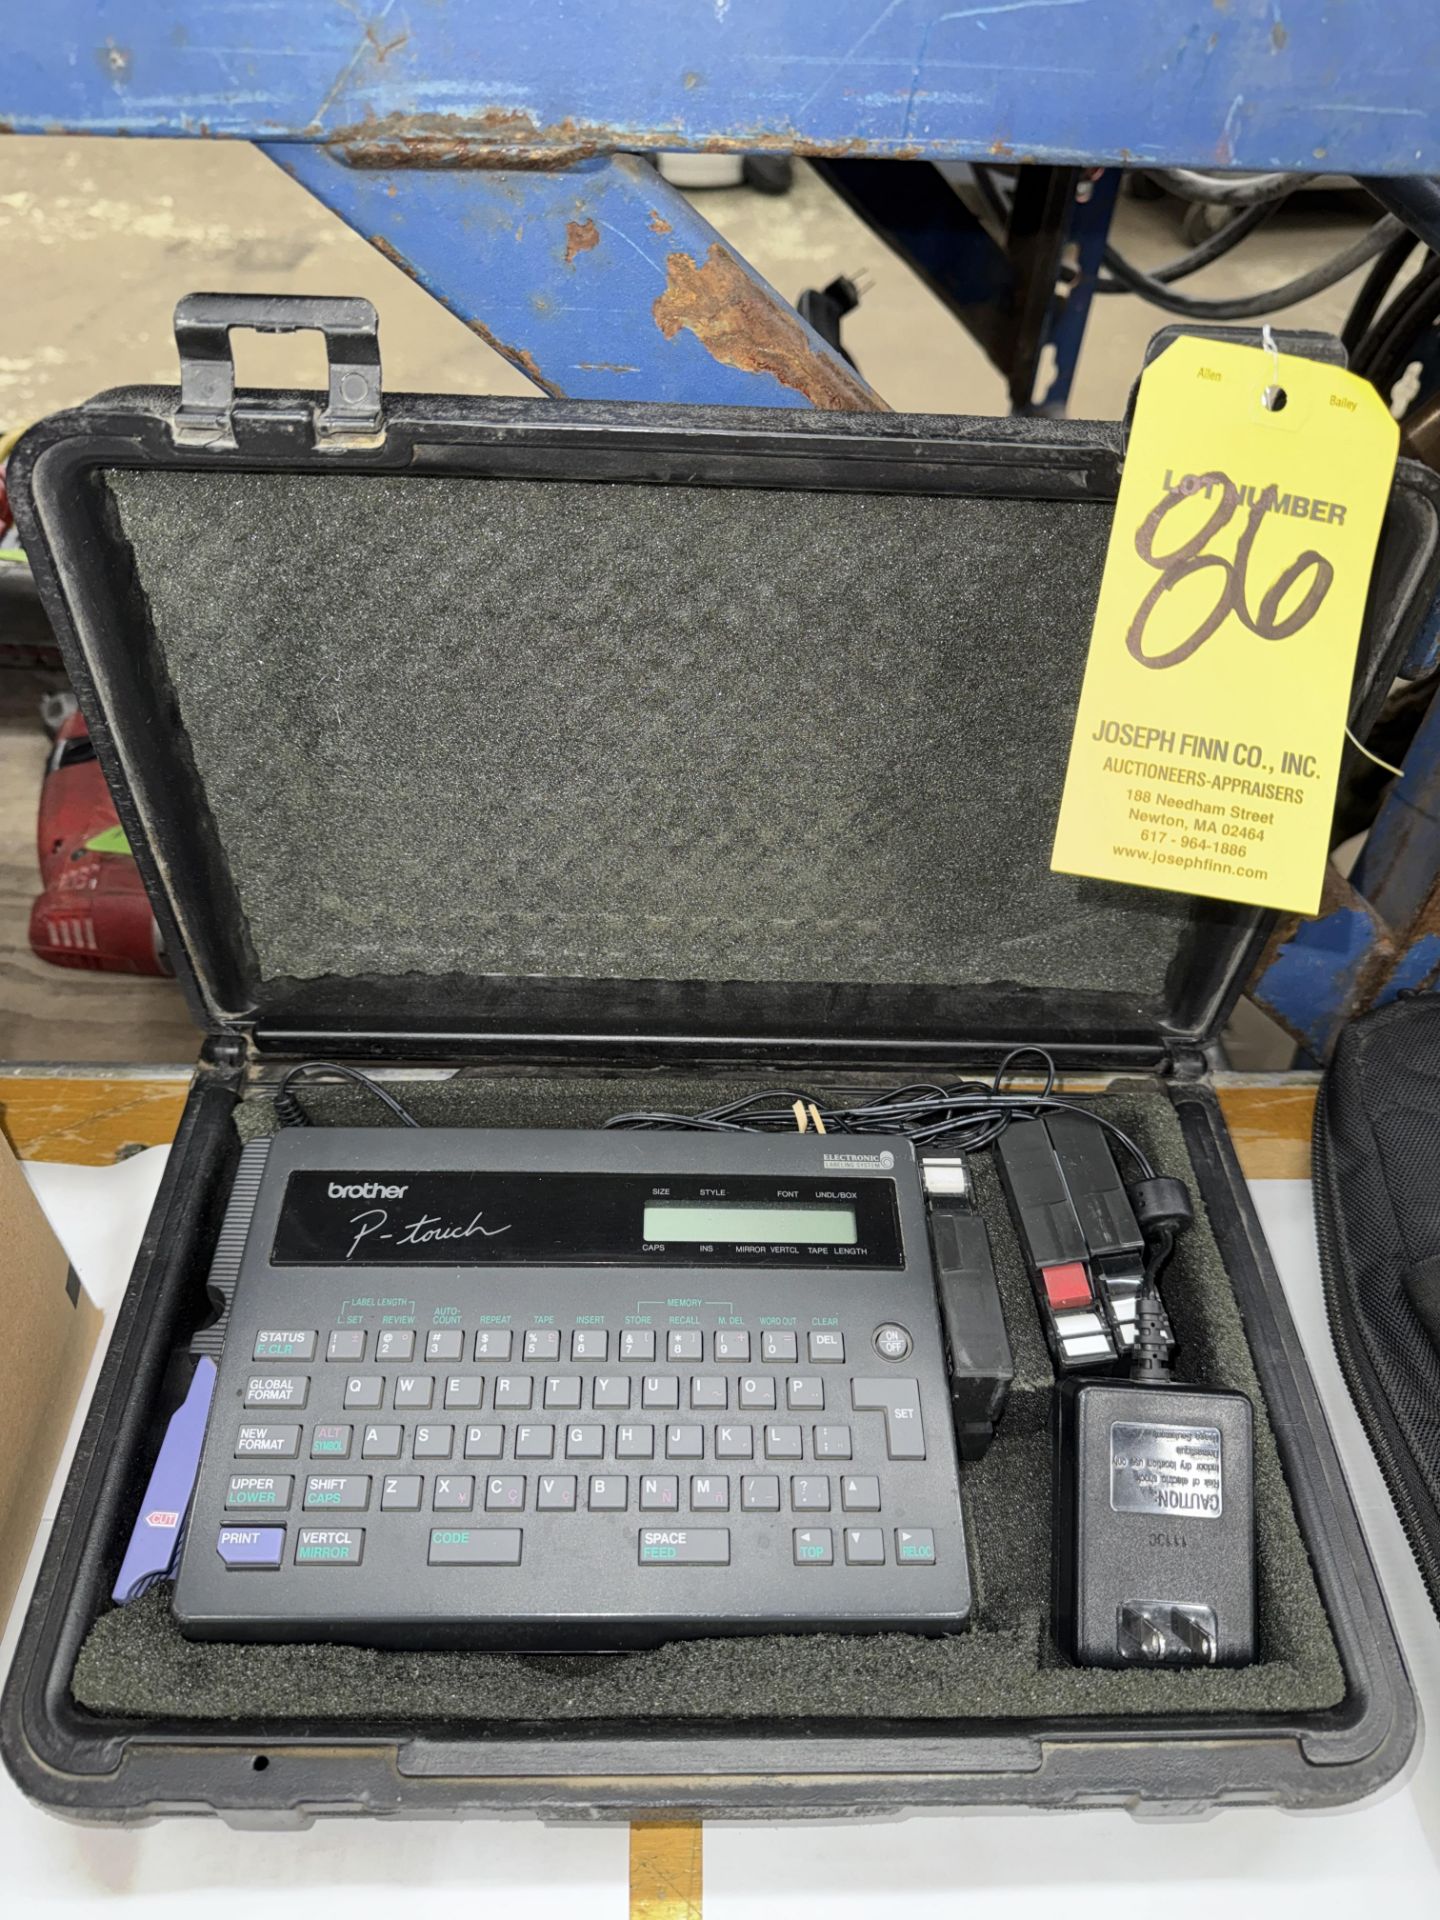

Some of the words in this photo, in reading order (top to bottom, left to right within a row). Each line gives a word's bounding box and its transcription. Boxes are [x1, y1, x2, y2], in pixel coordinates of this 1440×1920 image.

[1196, 367, 1222, 382] Allen
[1329, 394, 1358, 412] Bailey
[1162, 469, 1220, 499] LOT
[1234, 483, 1347, 526] NUMBER
[1125, 471, 1334, 670] 86
[1092, 720, 1175, 753] JOSEPH
[1179, 733, 1229, 762] FINN
[1233, 742, 1274, 774] CO.,
[1281, 751, 1321, 779] INC.
[1102, 756, 1304, 804] AUCTIONEERS-APPRAISERS
[1126, 789, 1151, 803] 188
[1156, 793, 1226, 816] Needham
[1230, 805, 1274, 825] Street
[1128, 807, 1188, 831] Newton,
[1193, 818, 1217, 834] MA
[1221, 824, 1265, 842] 02464
[1140, 829, 1167, 844] 617
[1180, 835, 1247, 858] 964-1886
[1112, 844, 1268, 881] www.josephfinn.com
[824, 1154, 880, 1162] ELECTRONIC
[327, 1182, 409, 1199] brother
[652, 1188, 670, 1196] SIZE
[700, 1188, 726, 1196] STYLE
[777, 1190, 799, 1198] FONT
[815, 1191, 858, 1199] UNDL/BOX
[642, 1244, 665, 1252] CAPS
[770, 1246, 799, 1254] VERTCL
[808, 1247, 829, 1255] TAPE
[834, 1247, 868, 1255] LENGTH
[352, 1298, 375, 1306] LABEL
[377, 1298, 407, 1306] LENGTH
[667, 1299, 702, 1308] MEMORY
[434, 1307, 460, 1316] AUTO-
[347, 1316, 363, 1324] SET
[382, 1316, 415, 1324] REVIEW
[433, 1316, 462, 1324] COUNT
[480, 1316, 511, 1324] REPEAT
[534, 1316, 554, 1324] TAPE
[576, 1316, 604, 1324] INSERT
[625, 1316, 652, 1324] STORE
[669, 1316, 700, 1325] RECALL
[729, 1316, 745, 1325] DEL
[759, 1317, 781, 1326] WORD
[782, 1317, 797, 1326] OUT
[812, 1317, 839, 1326] CLEAR
[259, 1332, 305, 1343] STATUS
[383, 1333, 393, 1343] @
[432, 1333, 441, 1341] #
[480, 1333, 489, 1343] $
[529, 1333, 538, 1342] %
[626, 1334, 634, 1344] &
[816, 1335, 837, 1345] DEL
[885, 1331, 898, 1340] ON
[269, 1344, 293, 1353] CLR
[381, 1344, 389, 1353] 2
[431, 1344, 438, 1353] 3
[480, 1344, 487, 1353] 4
[528, 1344, 536, 1353] 5
[577, 1344, 585, 1353] 6
[625, 1345, 632, 1354] 7
[674, 1345, 681, 1354] 8
[720, 1345, 727, 1354] 9
[769, 1345, 776, 1354] 0
[886, 1342, 901, 1352] OFF
[250, 1380, 294, 1389] GLOBAL
[350, 1380, 361, 1392] Q
[400, 1380, 414, 1391] W
[450, 1380, 460, 1391] E
[500, 1380, 510, 1391] R
[550, 1380, 560, 1391] T
[599, 1380, 609, 1391] Y
[648, 1381, 658, 1392] U
[745, 1381, 756, 1393] O
[793, 1381, 803, 1392] P
[248, 1390, 293, 1400] FORMAT
[894, 1408, 914, 1419] SET
[241, 1429, 267, 1439] NEW
[318, 1428, 342, 1439] ALT
[367, 1429, 378, 1441] A
[418, 1429, 429, 1441] S
[470, 1429, 481, 1441] D
[521, 1429, 531, 1441] F
[571, 1429, 583, 1442] G
[622, 1429, 632, 1441] H
[671, 1429, 681, 1441] J
[722, 1429, 732, 1441] K
[772, 1429, 780, 1441] L
[238, 1439, 285, 1450] FORMAT
[1146, 1458, 1177, 1469] location
[1180, 1460, 1192, 1471] dry
[1196, 1463, 1219, 1473] Indoor
[231, 1479, 274, 1490] UPPER
[310, 1479, 346, 1490] SHIFT
[438, 1480, 450, 1493] X
[491, 1480, 503, 1493] C
[543, 1480, 555, 1493] V
[1161, 1476, 1189, 1486] electric
[1192, 1478, 1200, 1487] of
[1204, 1478, 1219, 1489] Risk
[386, 1481, 397, 1493] Z
[594, 1481, 605, 1493] B
[646, 1481, 657, 1493] N
[697, 1481, 710, 1493] M
[229, 1492, 275, 1503] LOWER
[308, 1492, 341, 1503] CAPS
[1155, 1490, 1219, 1511] CAUTION:
[153, 1514, 176, 1524] CUT
[221, 1533, 260, 1544] PRINT
[302, 1533, 352, 1543] VERTCL
[432, 1532, 470, 1544] CODE
[645, 1533, 686, 1544] SPACE
[300, 1547, 349, 1558] MIRROR
[643, 1547, 676, 1558] FEED
[800, 1546, 823, 1558] TOP
[903, 1546, 933, 1558] RELOC
